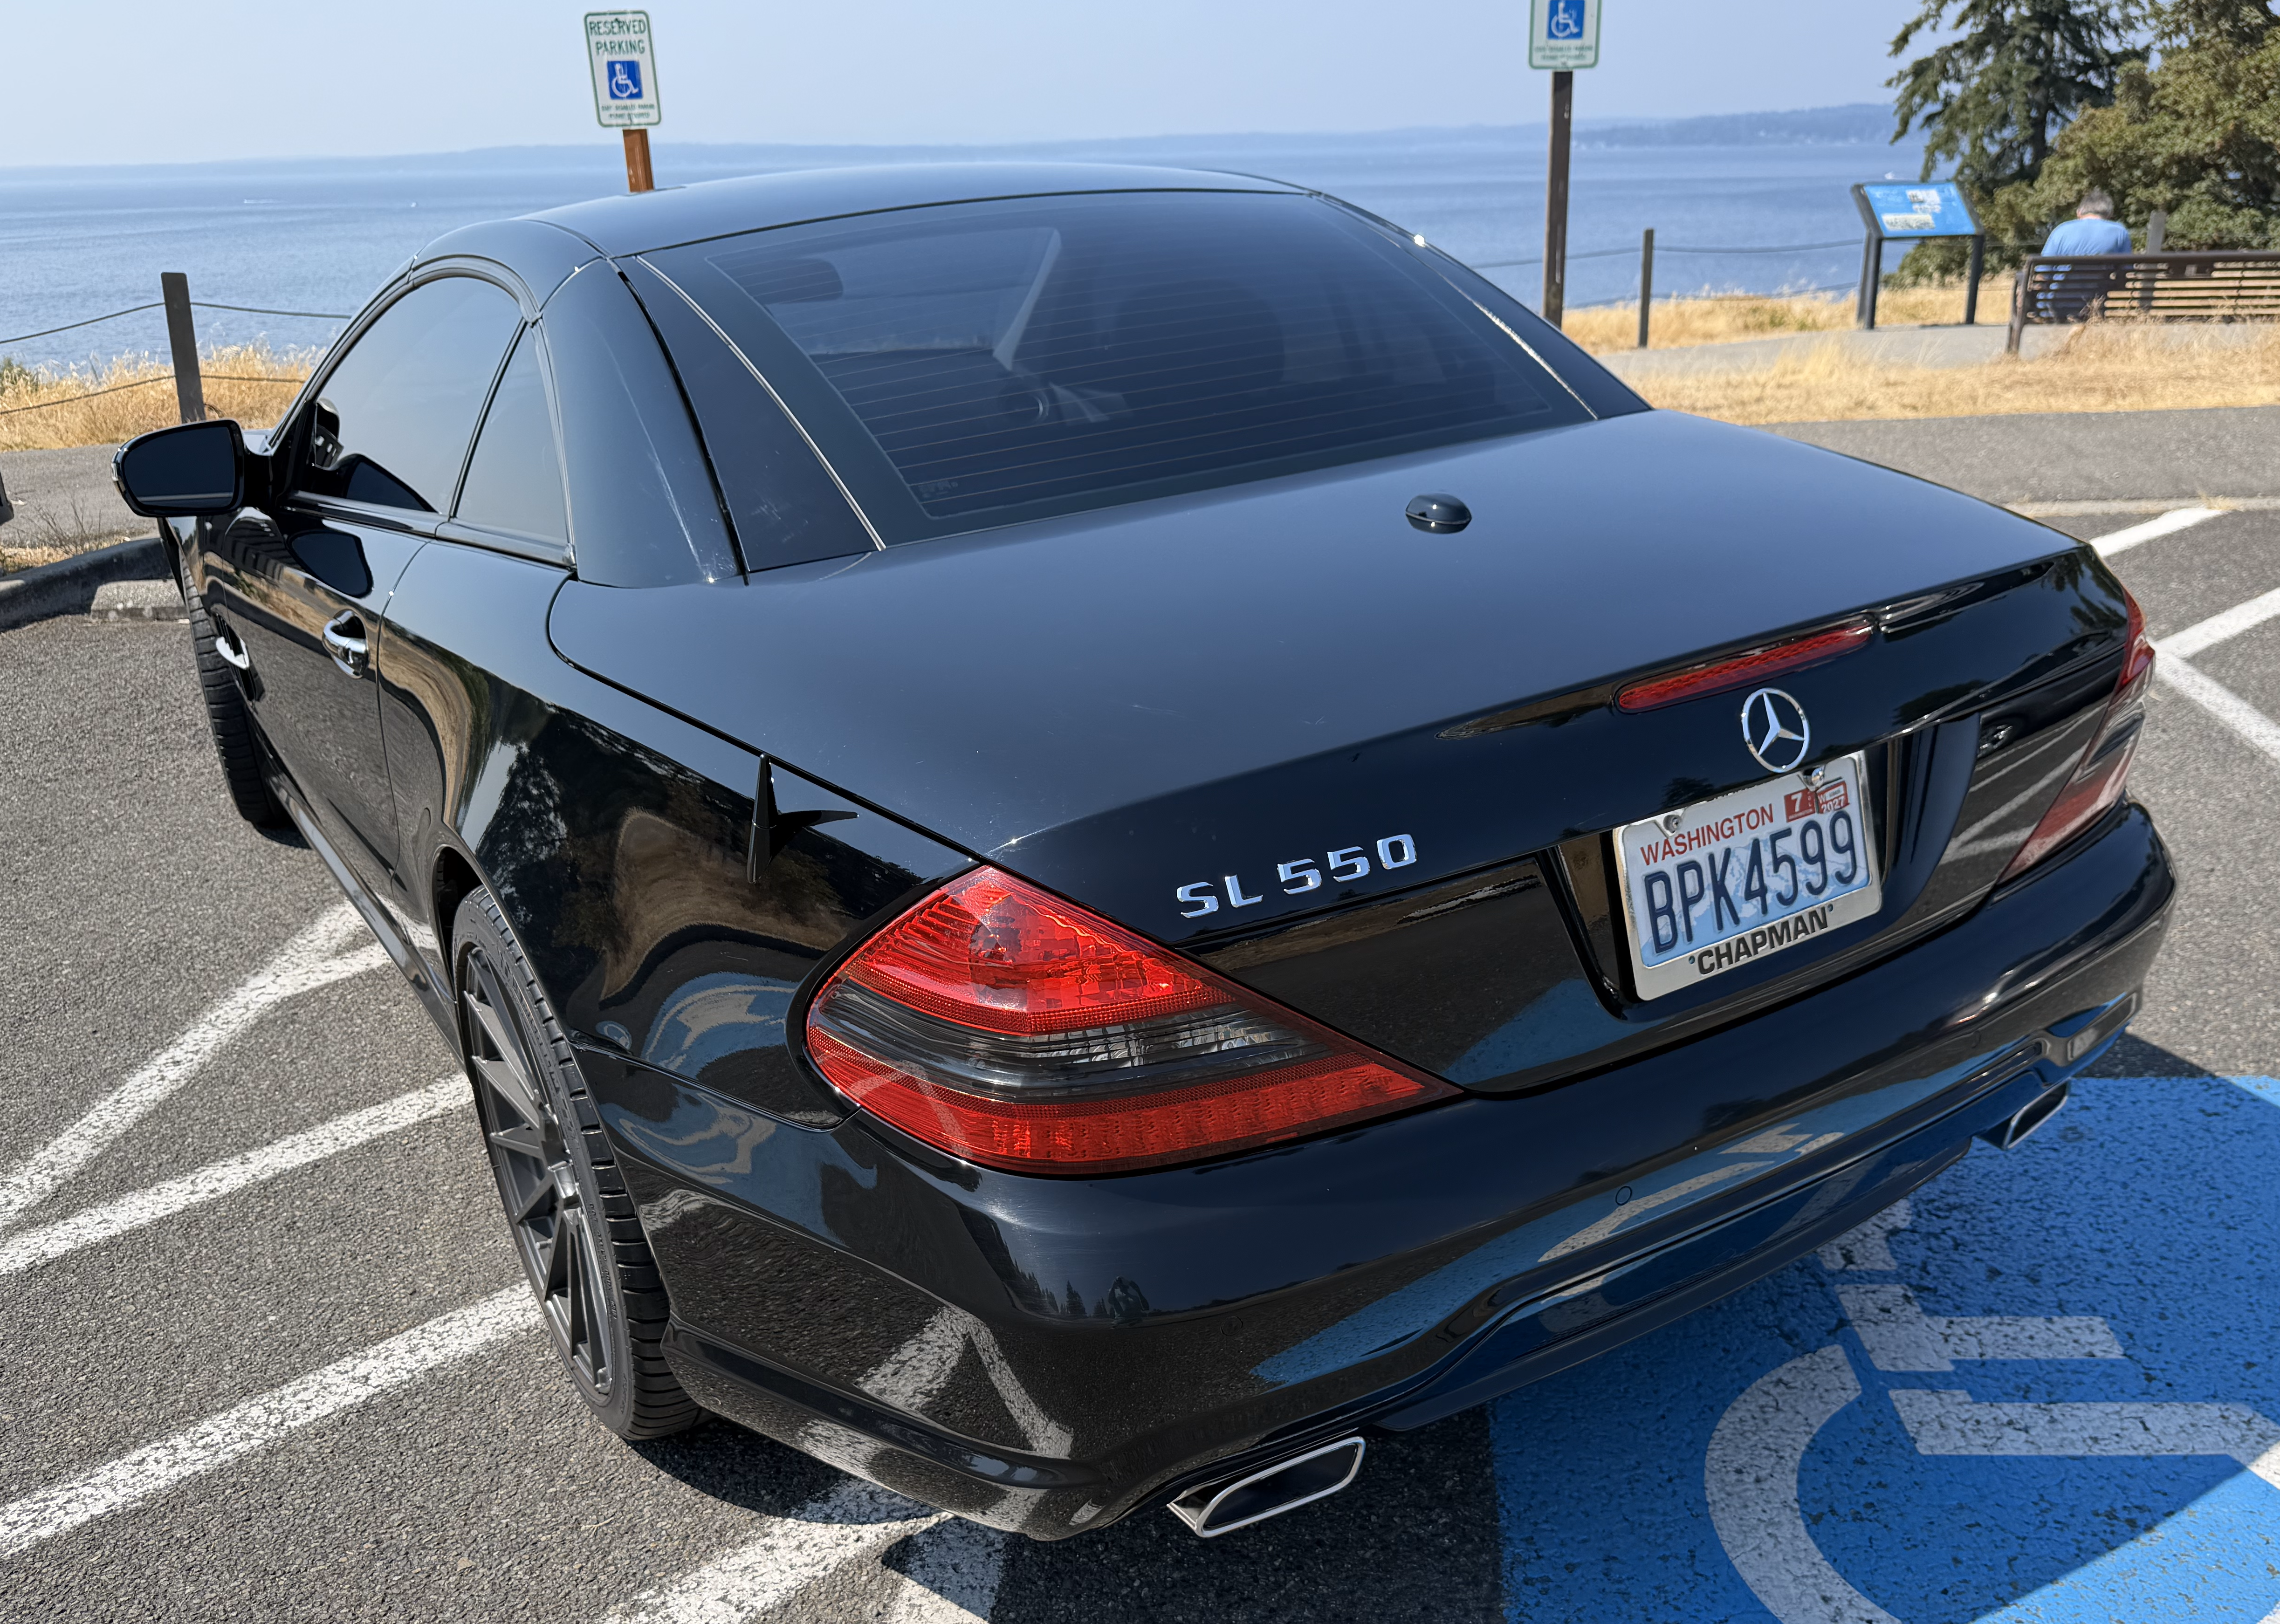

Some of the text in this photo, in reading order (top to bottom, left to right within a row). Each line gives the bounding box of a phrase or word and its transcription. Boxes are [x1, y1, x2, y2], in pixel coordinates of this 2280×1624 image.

[589, 20, 646, 36] RESERVED
[596, 39, 645, 55] PARKING
[1791, 792, 1803, 812] 7
[1821, 795, 1845, 813] 2027
[1640, 803, 1773, 866] WASHINGTON
[1176, 834, 1418, 918] SL 550
[1644, 811, 1857, 953] BPK4599
